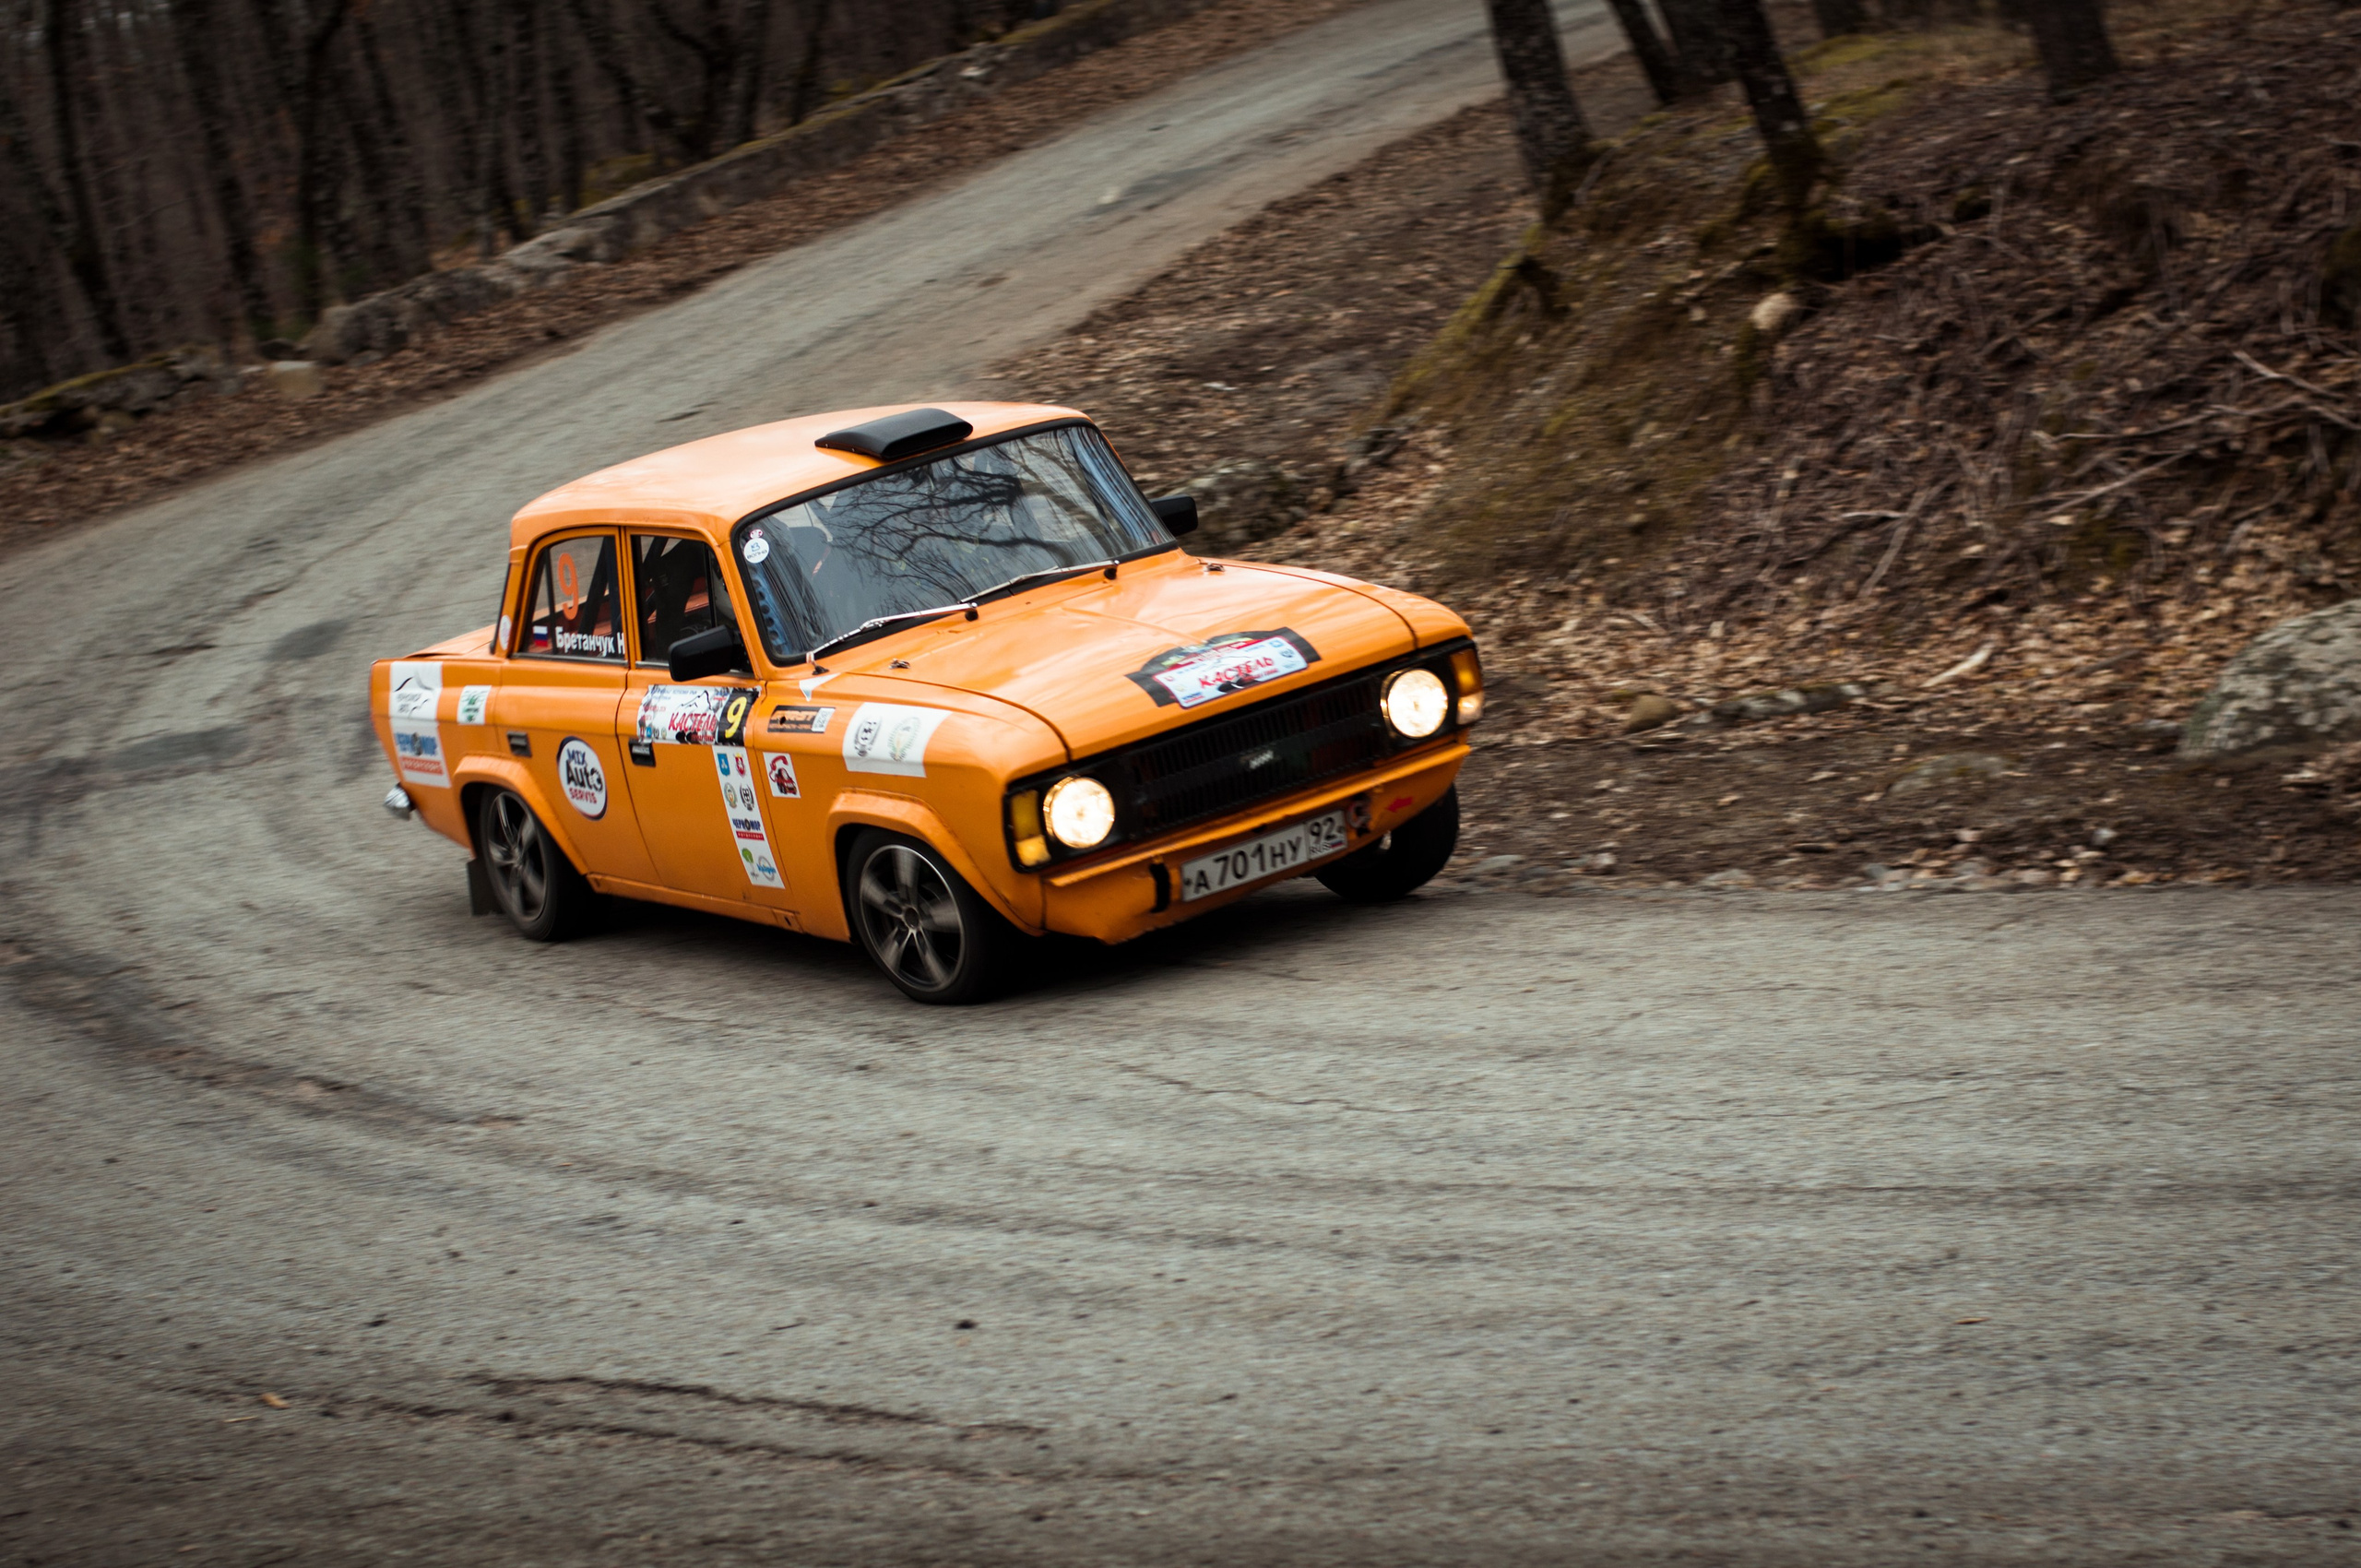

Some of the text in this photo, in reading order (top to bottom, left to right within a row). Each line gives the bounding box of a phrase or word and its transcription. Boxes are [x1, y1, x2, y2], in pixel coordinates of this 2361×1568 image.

[558, 553, 579, 620] 9
[555, 626, 615, 657] Бретанчук
[1197, 656, 1275, 689] КАСТЕЛЬ
[669, 711, 718, 733] КАСТЕЛЬ
[725, 695, 748, 738] 9
[566, 748, 587, 766] MIX
[1192, 816, 1337, 895] А701НУ 92
